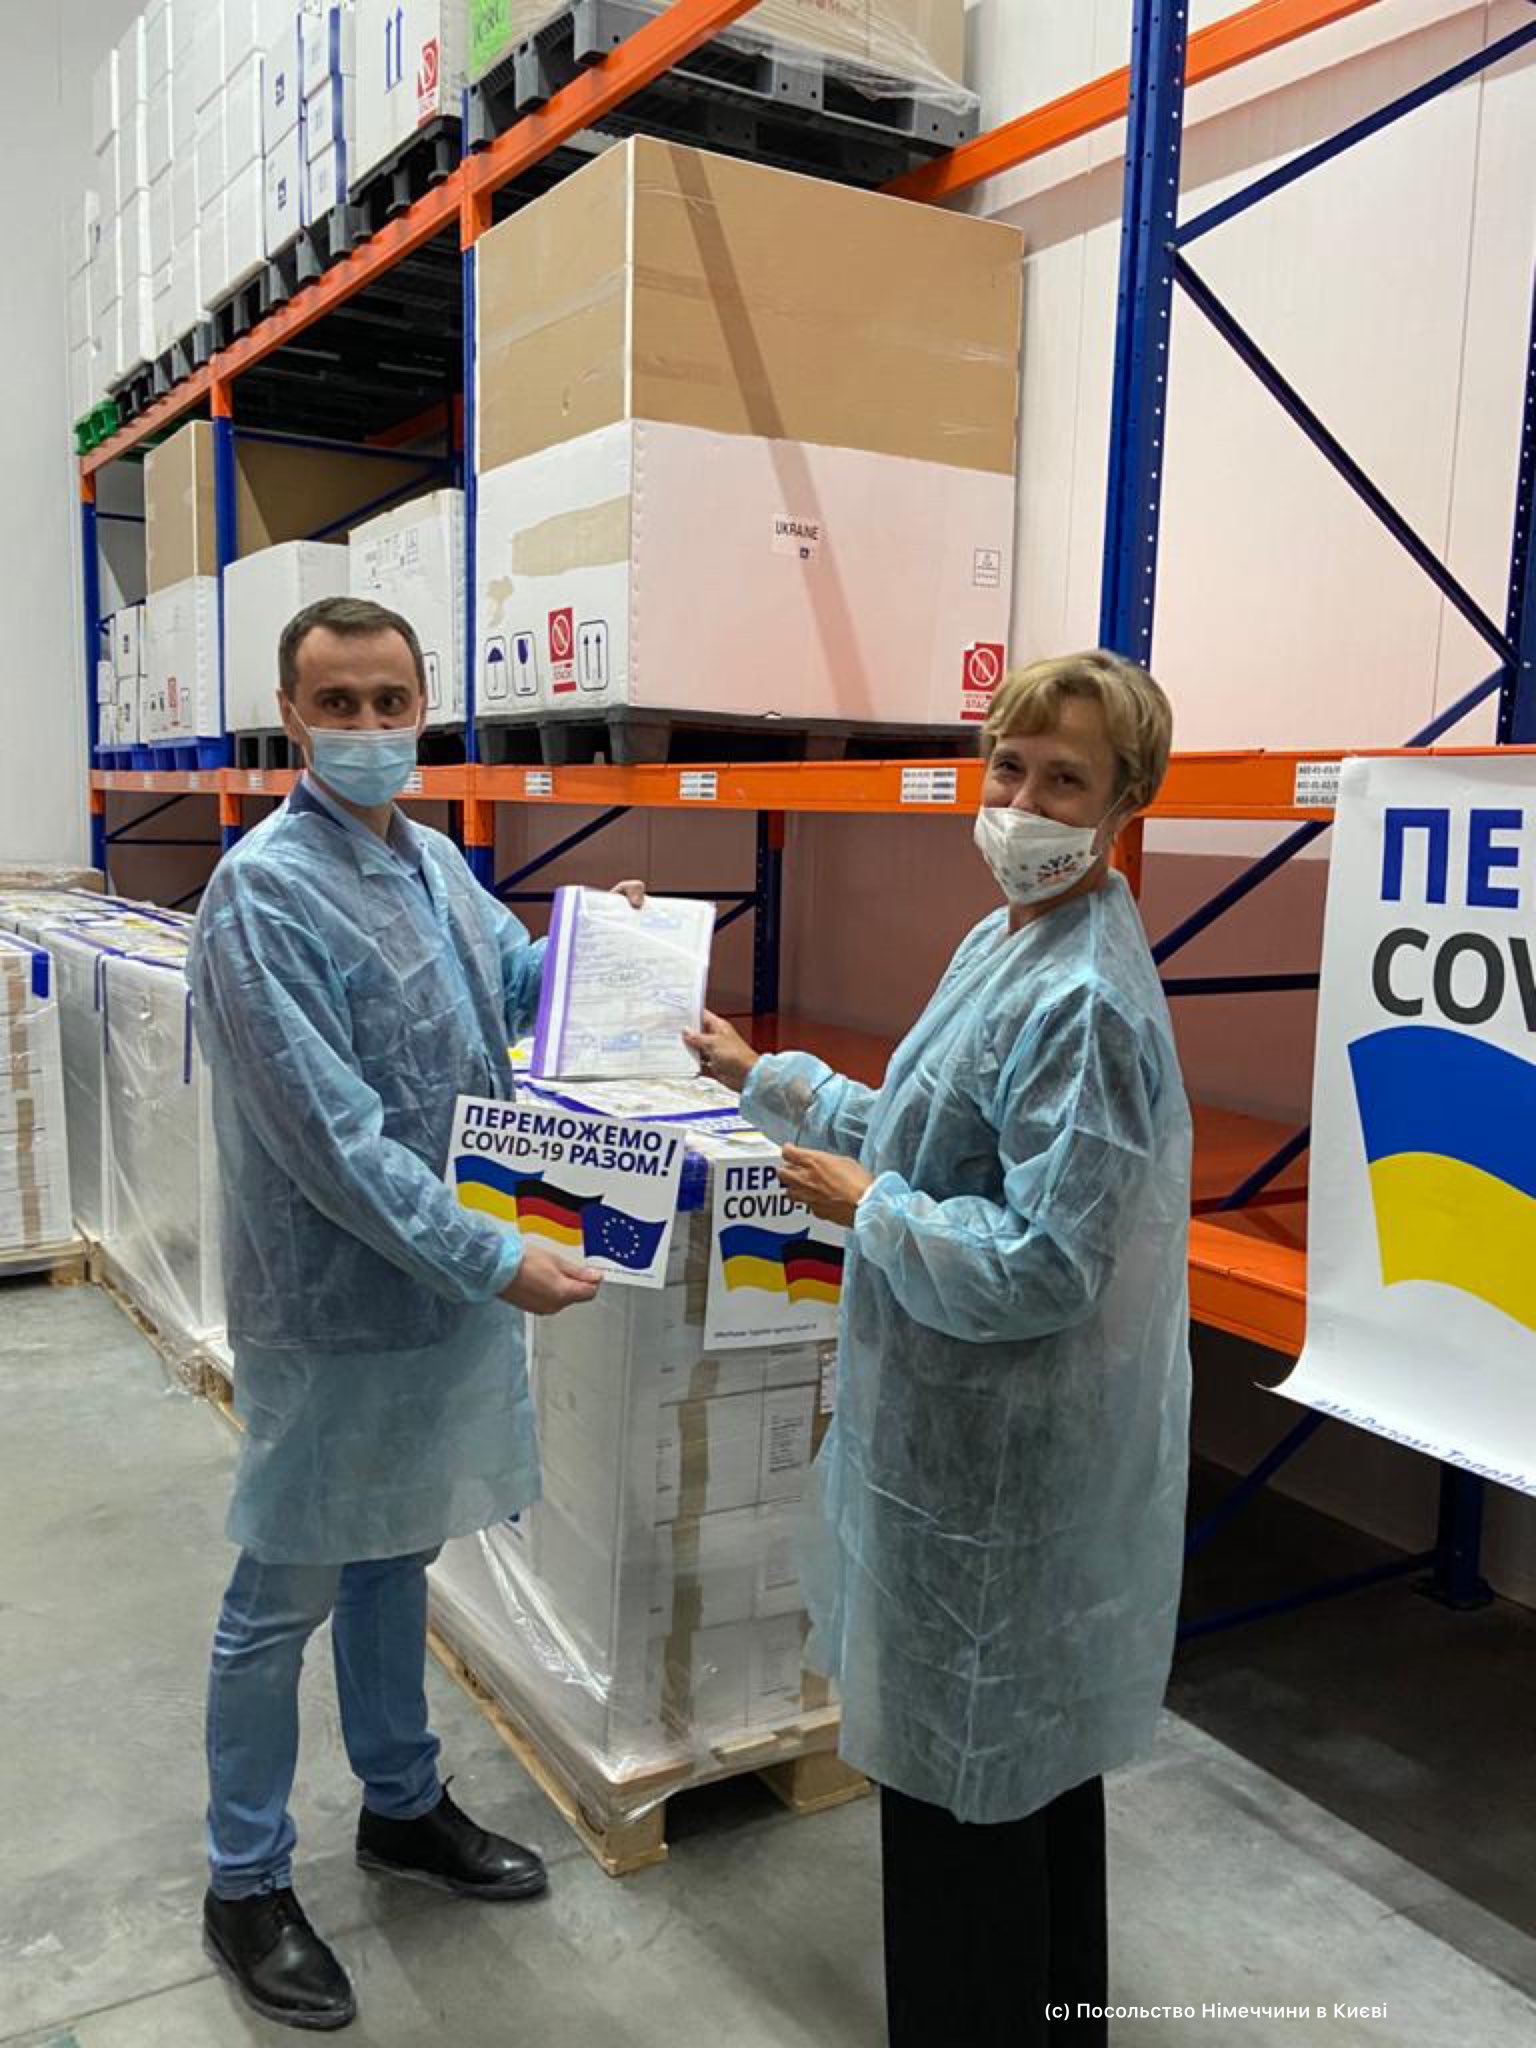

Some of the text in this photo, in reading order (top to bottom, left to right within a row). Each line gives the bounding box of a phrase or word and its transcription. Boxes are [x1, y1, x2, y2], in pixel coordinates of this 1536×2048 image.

[775, 520, 819, 540] UKRAINE
[1381, 807, 1523, 909] ПЕ
[465, 1104, 662, 1151] ПЕРЕМОЖЕМО
[461, 1129, 564, 1161] COVID-19
[725, 1166, 790, 1192] ПЕР
